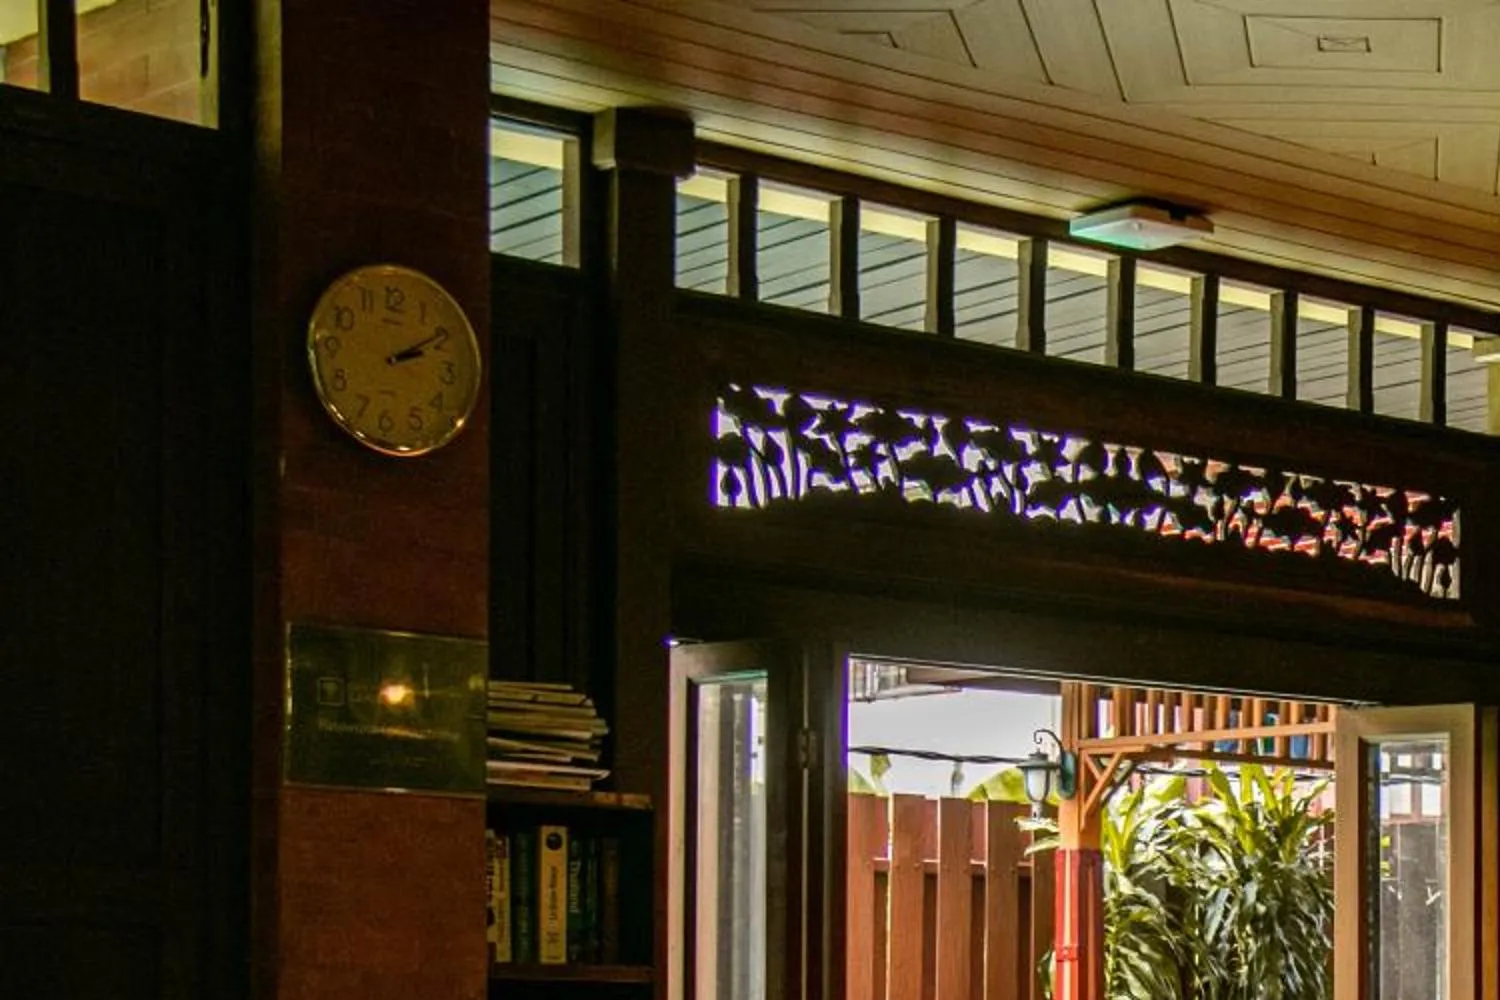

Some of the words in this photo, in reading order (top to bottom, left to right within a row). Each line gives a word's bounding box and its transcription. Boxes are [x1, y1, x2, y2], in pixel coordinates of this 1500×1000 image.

[359, 286, 374, 313] 11
[384, 285, 406, 314] 12
[334, 304, 356, 331] 10
[418, 303, 428, 324] 1
[324, 334, 341, 358] 9
[432, 325, 449, 351] 2
[332, 367, 348, 392] 8
[440, 361, 457, 386] 3
[356, 394, 371, 418] 7
[429, 391, 446, 414] 4
[377, 409, 395, 433] 6
[407, 405, 424, 431] 5
